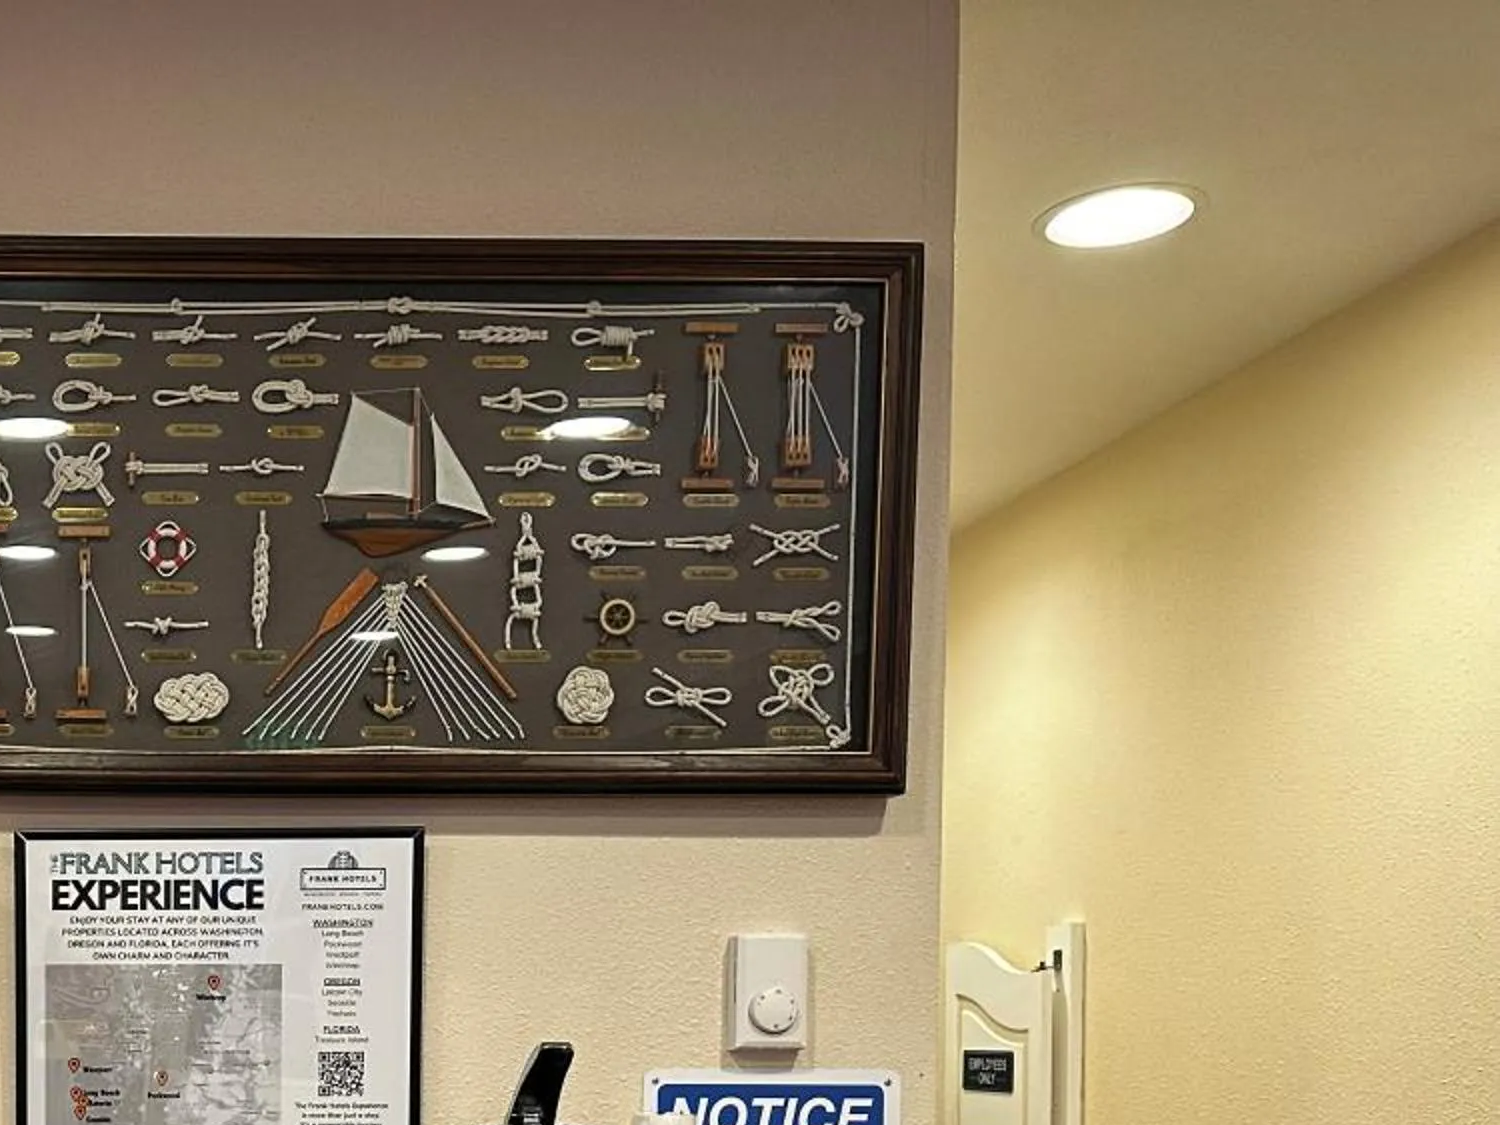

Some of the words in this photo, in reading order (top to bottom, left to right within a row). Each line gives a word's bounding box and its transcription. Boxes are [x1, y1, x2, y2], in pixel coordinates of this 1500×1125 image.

[59, 852, 150, 875] FRANK
[155, 852, 264, 875] HOTELS
[309, 875, 339, 883] FRANK
[342, 875, 378, 883] HOTELS
[51, 878, 265, 911] EXPERIENCE
[69, 915, 98, 926] ENJOY
[100, 915, 125, 925] YOUR
[126, 915, 150, 925] STAY
[152, 915, 164, 925] AT
[166, 915, 184, 925] ANY
[186, 915, 198, 925] OF
[200, 915, 220, 925] OUR
[61, 927, 116, 937] PROPERTIES
[118, 927, 159, 937] LOCATED
[161, 927, 199, 937] ACROSS
[107, 939, 127, 949] AND
[171, 939, 197, 949] EACH
[92, 951, 116, 961] OWN
[117, 951, 151, 961] CHARM
[152, 951, 173, 961] AND
[174, 951, 230, 961] CHARACTER
